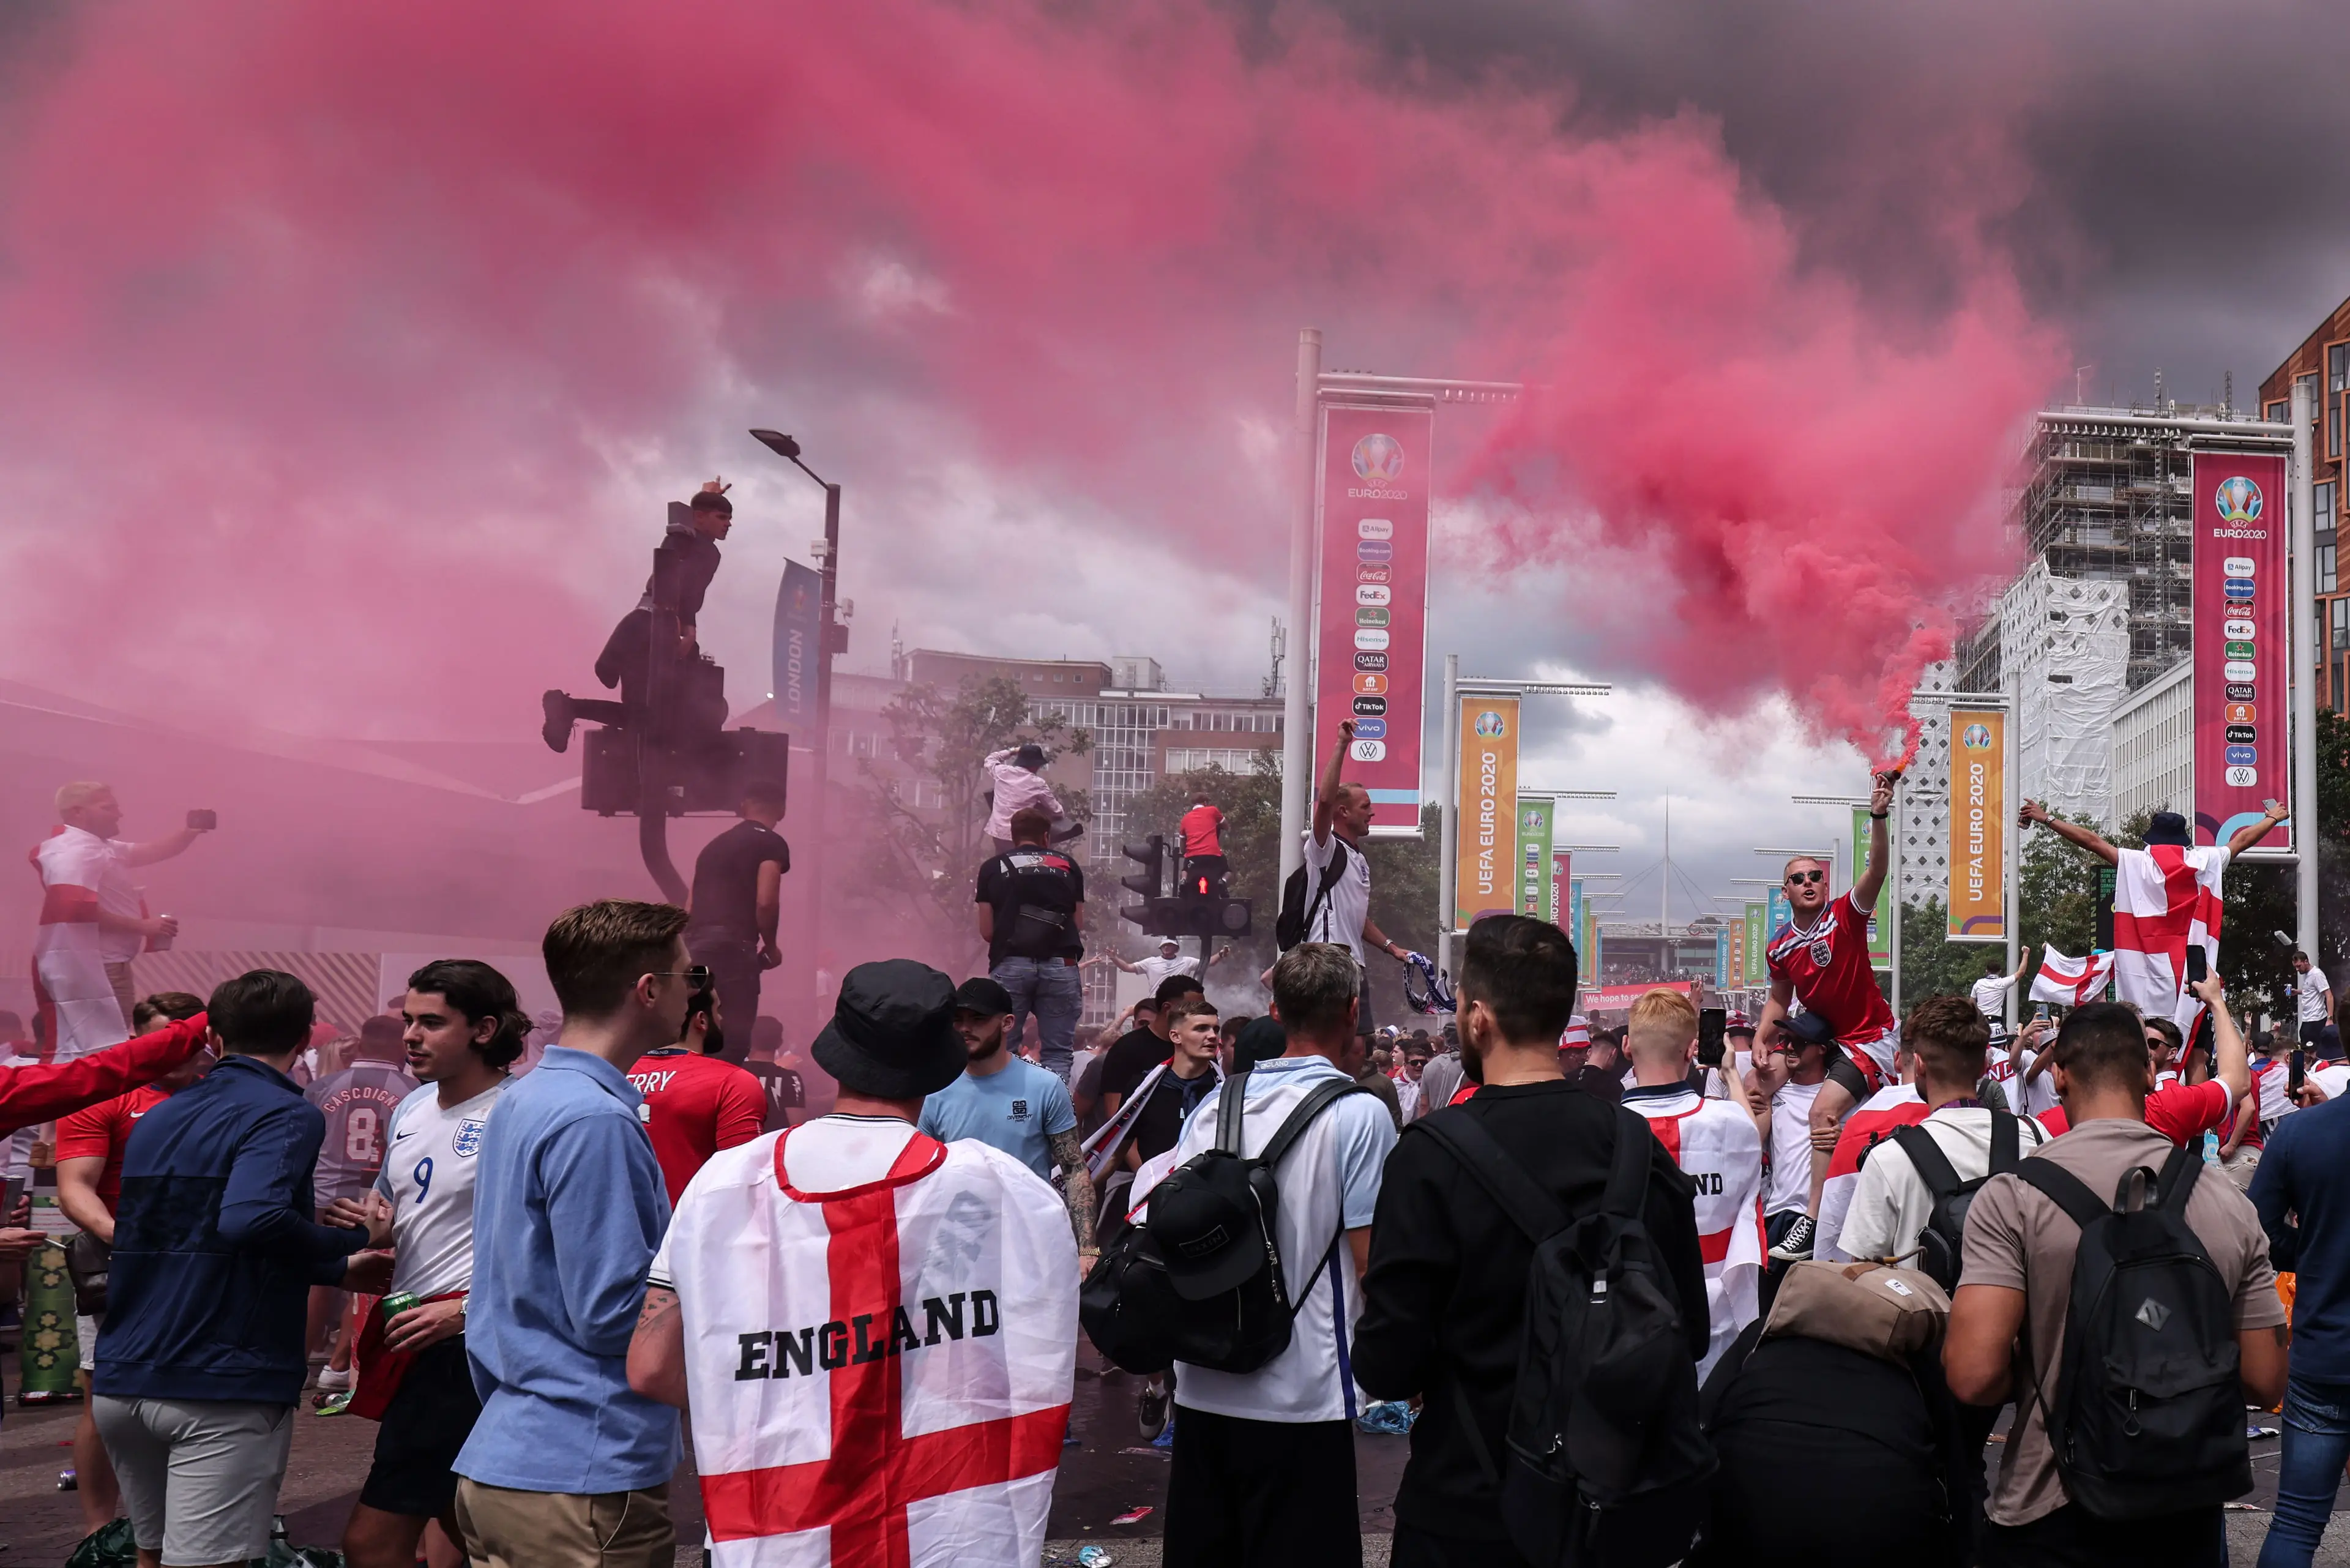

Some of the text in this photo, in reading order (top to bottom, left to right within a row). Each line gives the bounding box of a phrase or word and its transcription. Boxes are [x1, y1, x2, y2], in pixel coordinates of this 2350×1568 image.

[1348, 488, 1408, 500] EURO2020
[2214, 528, 2267, 539] EURO2020
[1360, 590, 1386, 600] FedEx
[2228, 625, 2251, 634] FedEx
[1357, 655, 1385, 663] QATAR
[788, 629, 802, 715] LONDON
[1479, 752, 1496, 894] UEFA EURO 2020
[1969, 763, 1984, 901] UEFA EURO 2020
[1005, 867, 1067, 878] JEANS
[1586, 995, 1598, 1004] We
[1600, 995, 1619, 1004] hope
[1988, 1062, 2014, 1081] ND
[346, 1108, 374, 1160] 8
[414, 1157, 433, 1204] 9
[1695, 1173, 1723, 1196] ND
[734, 1289, 999, 1382] ENGLAND
